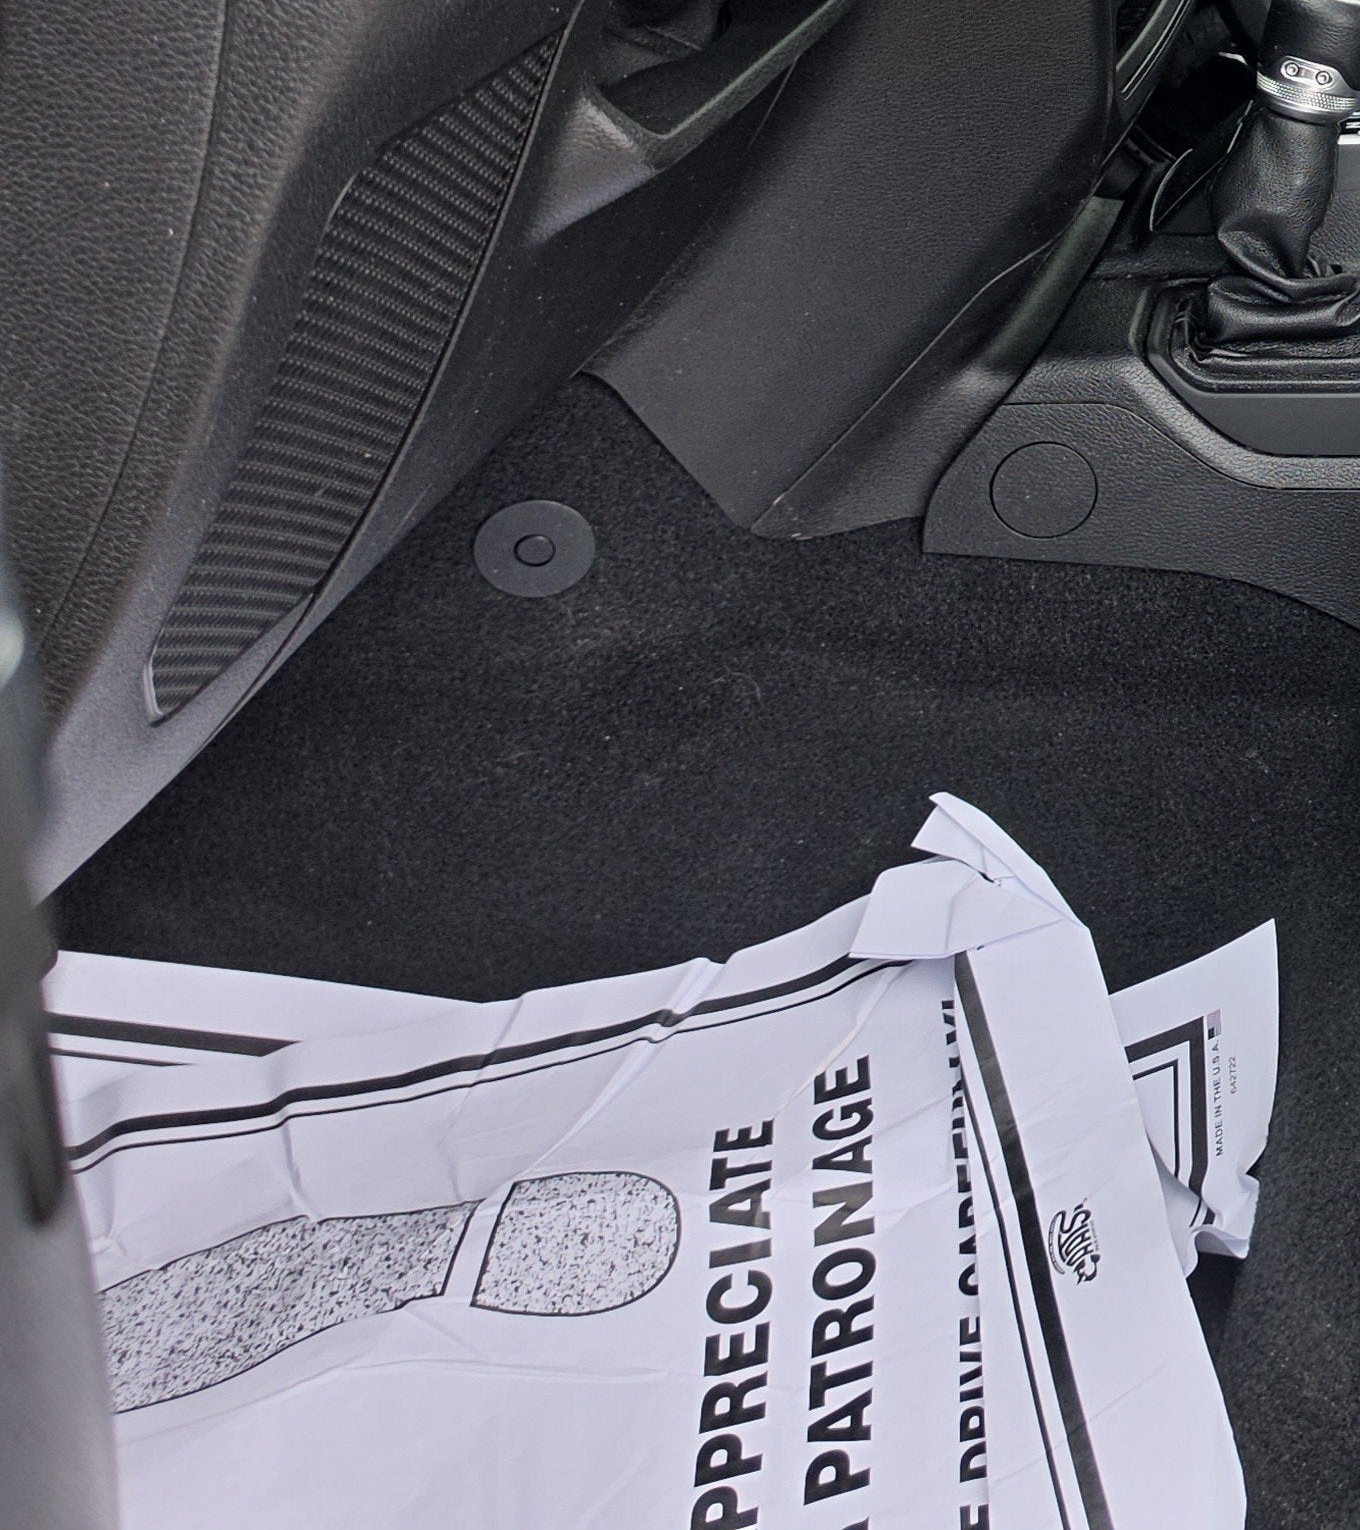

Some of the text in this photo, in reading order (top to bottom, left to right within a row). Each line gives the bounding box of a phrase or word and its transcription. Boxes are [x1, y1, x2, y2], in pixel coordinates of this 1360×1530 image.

[1213, 1077, 1222, 1103] THE
[1215, 1104, 1222, 1118] IN
[1214, 1120, 1224, 1157] MADE
[804, 1055, 876, 1505] PATRONAGE
[690, 1118, 774, 1530] PPRECIATE
